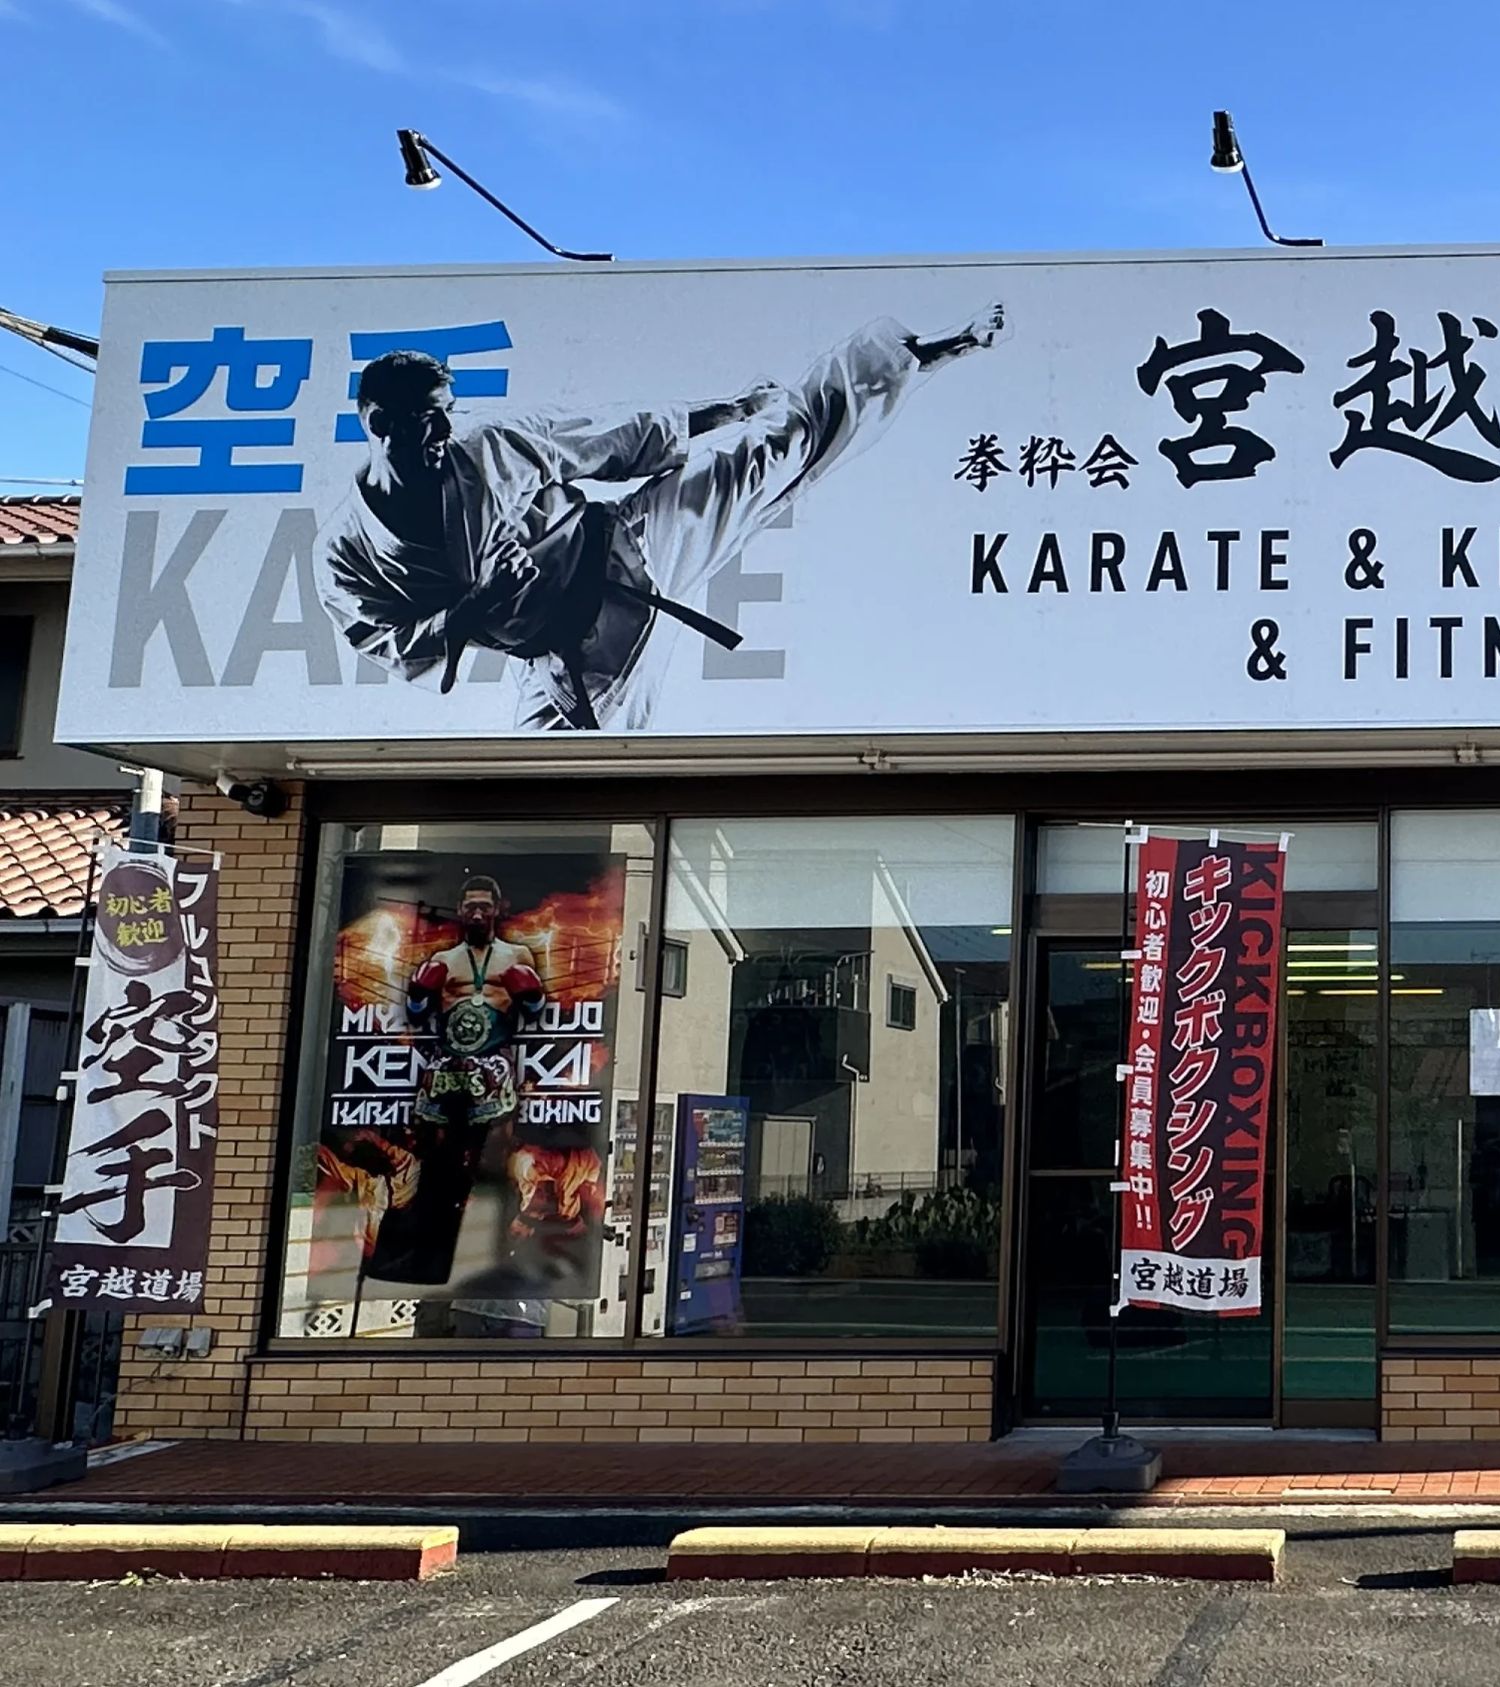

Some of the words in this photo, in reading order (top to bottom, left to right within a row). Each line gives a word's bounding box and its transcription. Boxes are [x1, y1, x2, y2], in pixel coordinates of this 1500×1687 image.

[971, 529, 1291, 593] KARATE
[1344, 526, 1386, 590] &
[108, 508, 794, 688] KAE
[1246, 618, 1287, 682] &
[104, 886, 173, 917] 初心者
[117, 918, 168, 947] 歓迎
[177, 872, 218, 1149] フルコンタクト
[1166, 854, 1232, 1250] キックボクシング
[1221, 850, 1278, 1258] KICKBOXING
[59, 980, 201, 1243] 空手
[332, 1101, 414, 1126] KARAT
[60, 1264, 203, 1301] 宮越道場
[1130, 1257, 1249, 1299] 宮越道場
